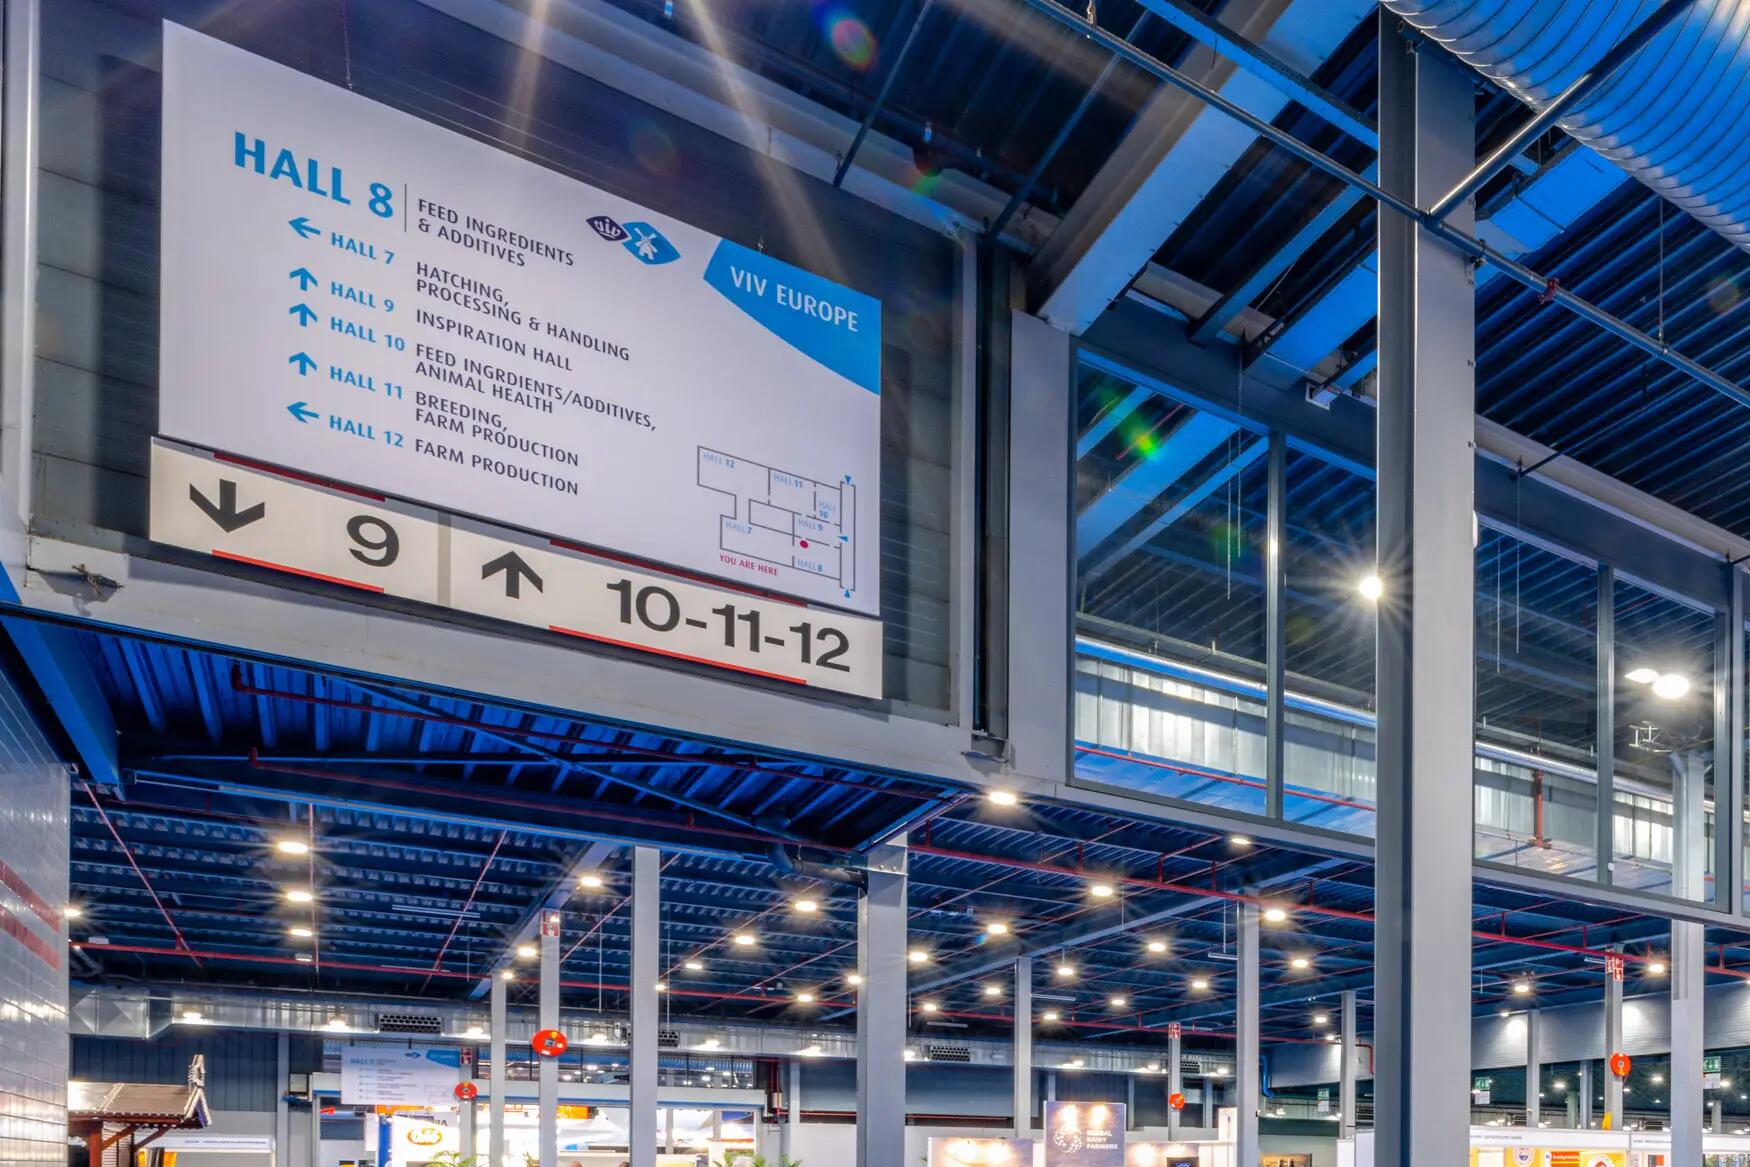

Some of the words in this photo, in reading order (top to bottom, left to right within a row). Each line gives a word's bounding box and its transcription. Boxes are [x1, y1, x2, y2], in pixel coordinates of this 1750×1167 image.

[234, 131, 351, 205] HALL
[368, 182, 394, 218] 8
[330, 232, 377, 260] HALL
[384, 250, 395, 265] 7
[418, 198, 458, 225] FEED
[466, 216, 575, 267] INGREDIENTS
[418, 218, 431, 233] &
[437, 225, 526, 268] ADDITIVES
[330, 281, 377, 309] HALL
[383, 299, 395, 313] 9
[416, 261, 510, 307] HATCHING,
[730, 266, 767, 297] VIV
[776, 283, 859, 333] EUROPE
[330, 316, 377, 343] HALL
[384, 334, 406, 352] 10
[416, 279, 521, 326] PROCESSING
[528, 316, 540, 332] &
[546, 322, 630, 362] HANDLING
[416, 309, 526, 357] INSPIRATION
[533, 346, 572, 372] HALL
[330, 365, 376, 392] HALL
[383, 382, 403, 400] 11
[415, 343, 456, 369] FEED
[464, 358, 657, 432] INGRDIENTS/ADDITIVES,
[415, 361, 485, 394] ANIMAL
[492, 383, 553, 414] HEALTH
[329, 414, 377, 441] HALL
[382, 428, 404, 449] 12
[415, 391, 508, 434] BREEDING,
[415, 409, 465, 435] FARM
[472, 424, 579, 467] PRODUCTION
[703, 452, 723, 465] HALL
[725, 459, 735, 468] 12
[415, 439, 465, 465] FARM
[471, 455, 579, 496] PRODUCTION
[773, 473, 794, 487] HALL
[746, 525, 752, 534] 7
[798, 518, 816, 530] HALL
[816, 521, 823, 532] 9
[819, 510, 828, 519] 10
[346, 515, 400, 568] 9
[719, 554, 736, 565] YOU
[739, 560, 755, 570] ARE
[758, 565, 779, 576] HERE
[797, 559, 816, 570] HALL
[607, 578, 851, 673] 10-11-12
